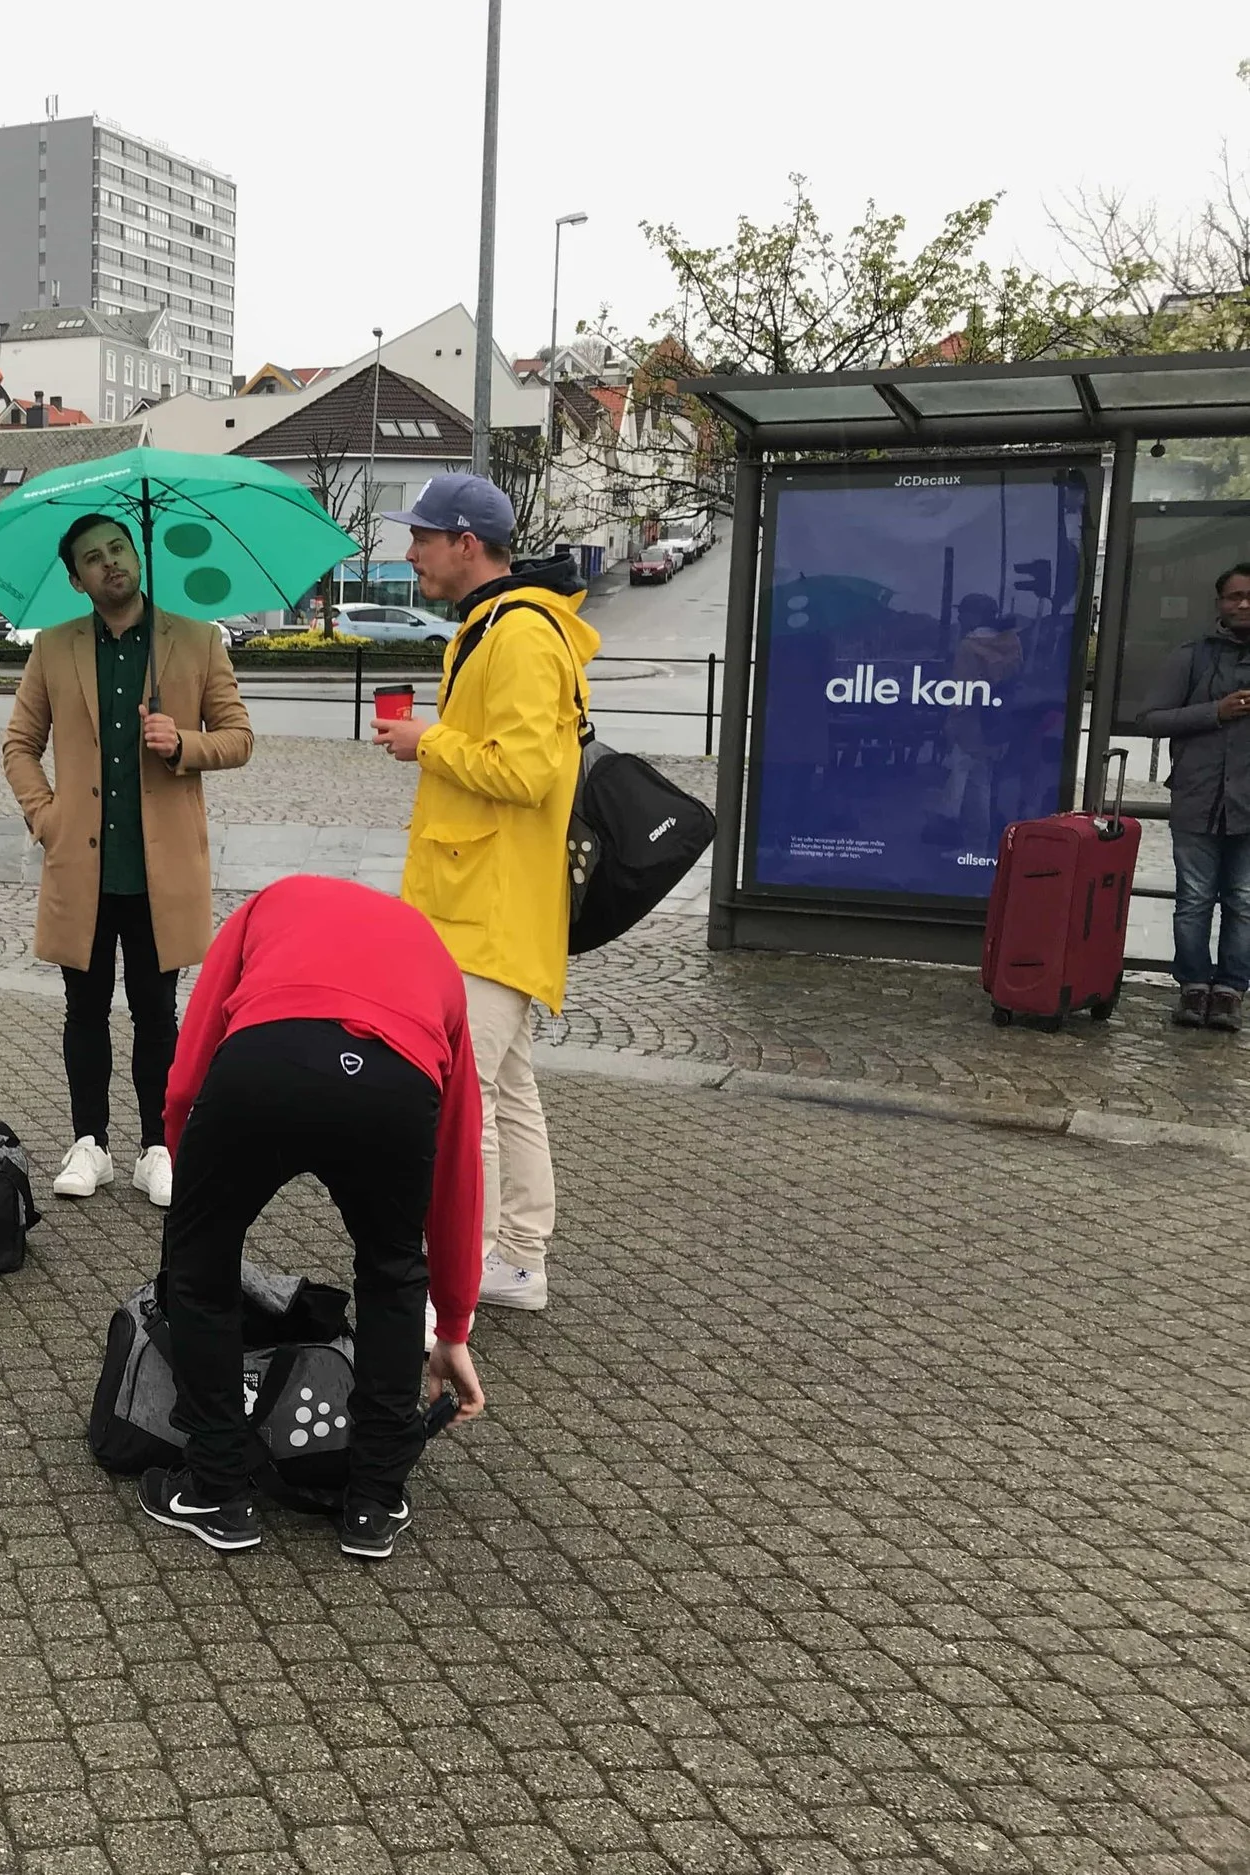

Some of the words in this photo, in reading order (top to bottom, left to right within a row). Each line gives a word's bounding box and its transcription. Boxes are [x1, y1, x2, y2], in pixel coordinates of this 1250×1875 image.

[894, 475, 962, 487] JCDecaux
[825, 664, 900, 704] alle
[911, 665, 1003, 707] kan.
[648, 819, 671, 842] CRAFT
[957, 852, 998, 867] allserv
